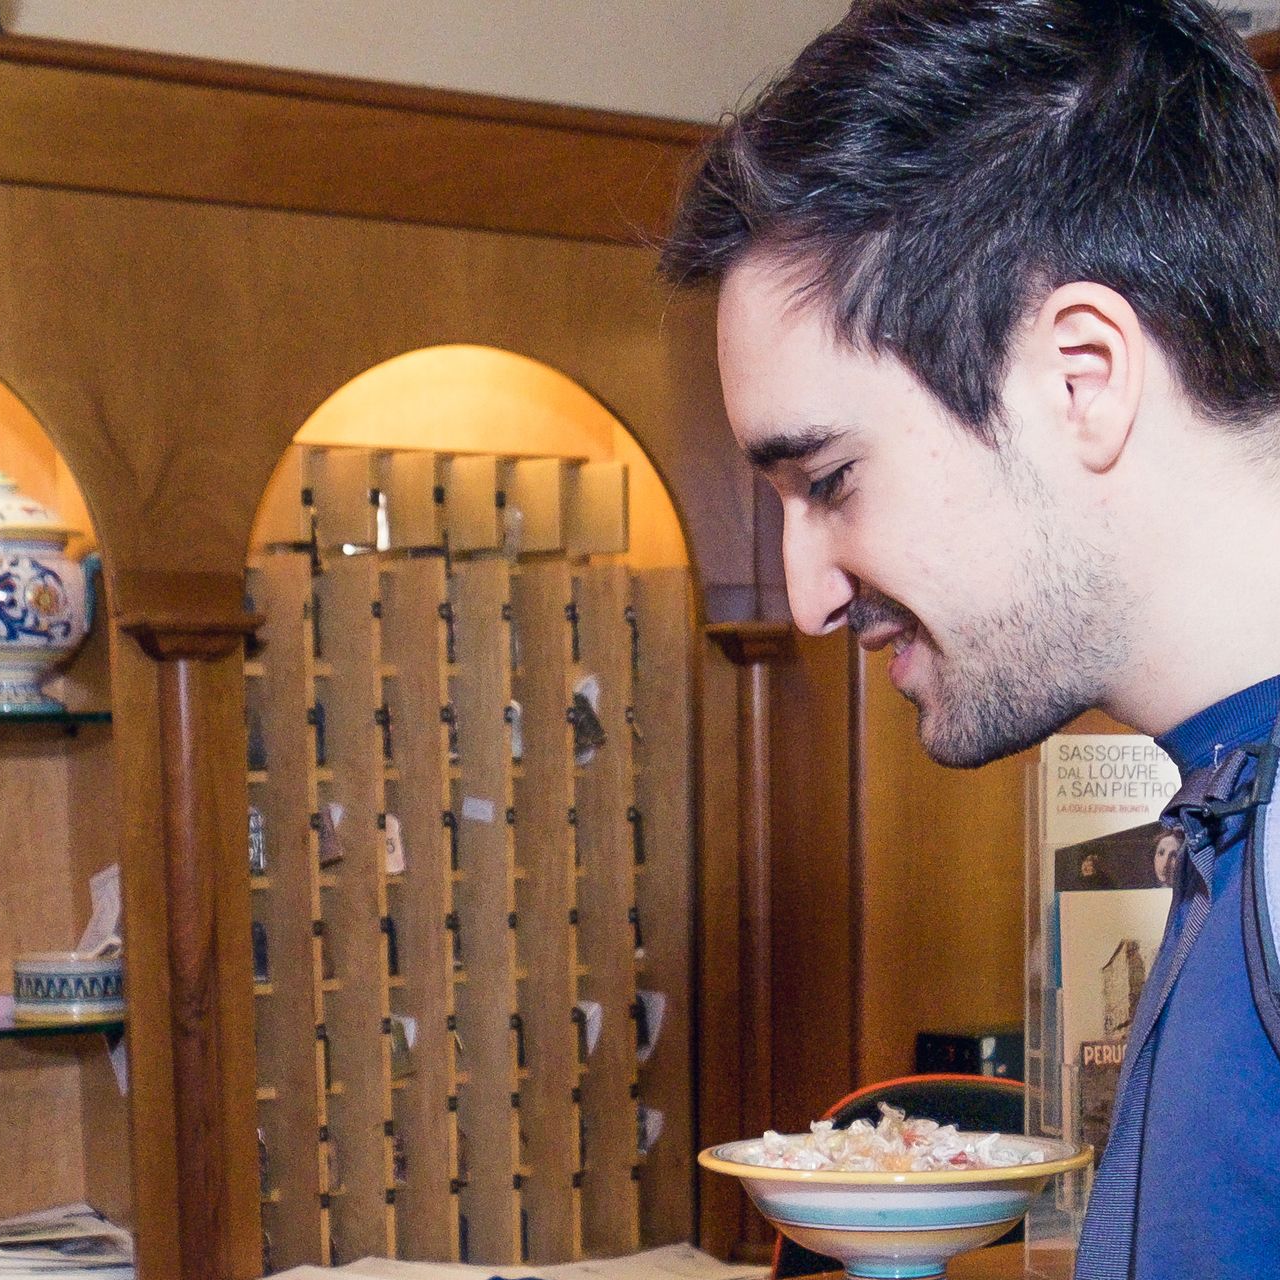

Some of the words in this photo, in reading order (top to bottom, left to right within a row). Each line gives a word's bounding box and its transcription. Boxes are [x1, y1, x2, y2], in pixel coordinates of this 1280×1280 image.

[1059, 745, 1170, 761] SASSOFERR
[1057, 767, 1084, 779] DAL
[1088, 763, 1159, 780] LOUVRE
[1057, 785, 1067, 797] A
[1071, 781, 1107, 798] SAN
[1111, 782, 1177, 798] PIETRO
